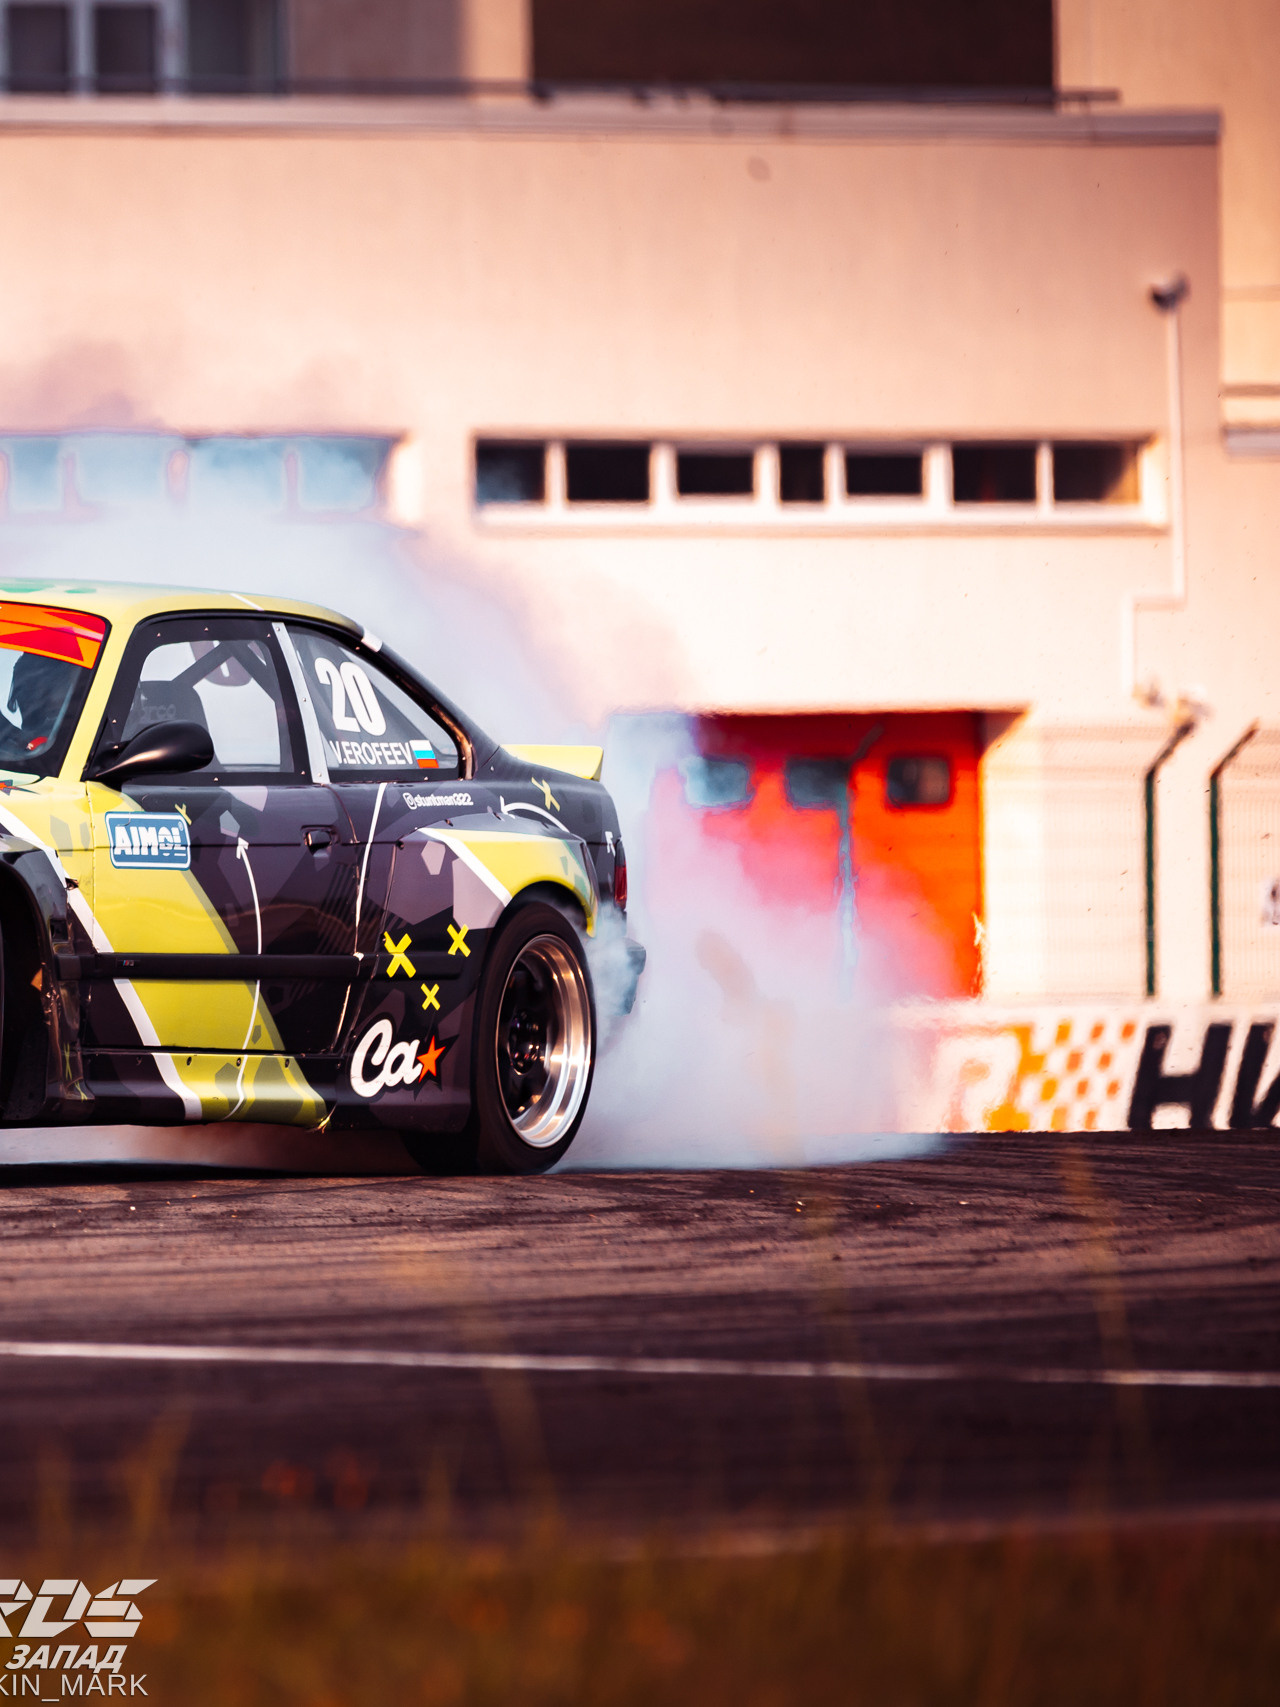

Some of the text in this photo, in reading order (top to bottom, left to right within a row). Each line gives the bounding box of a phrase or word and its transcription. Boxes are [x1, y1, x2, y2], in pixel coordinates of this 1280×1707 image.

[314, 657, 387, 736] 20
[329, 740, 414, 765] V.EROFEEV
[114, 826, 187, 857] AIMOL
